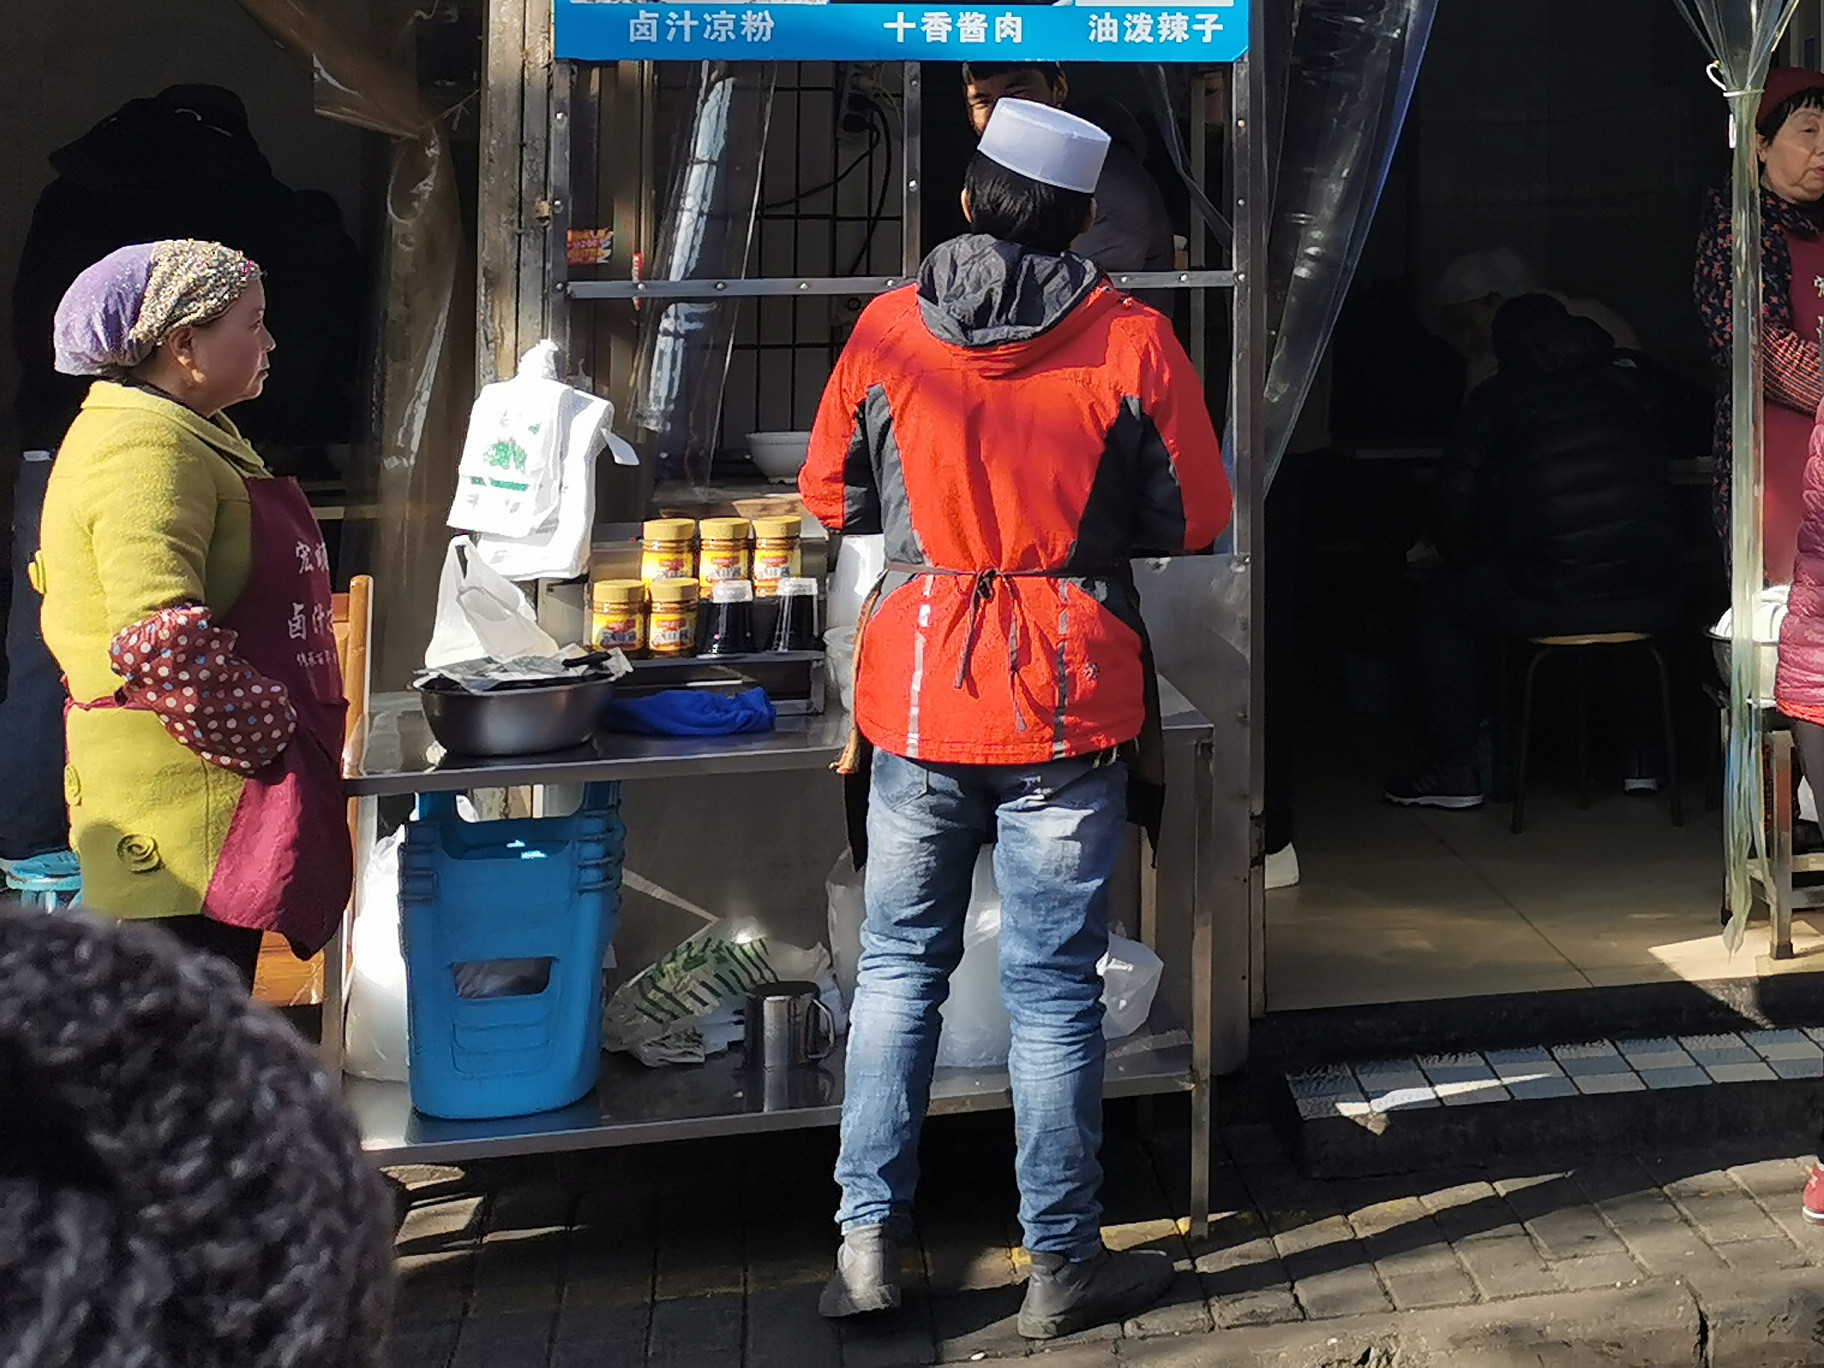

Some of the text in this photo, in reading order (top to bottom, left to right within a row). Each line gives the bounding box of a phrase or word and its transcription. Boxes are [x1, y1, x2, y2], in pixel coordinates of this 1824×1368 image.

[628, 10, 775, 44] 卤汁凉粉
[884, 11, 1023, 44] 十香酱肉
[1088, 12, 1224, 44] 油泼辣子
